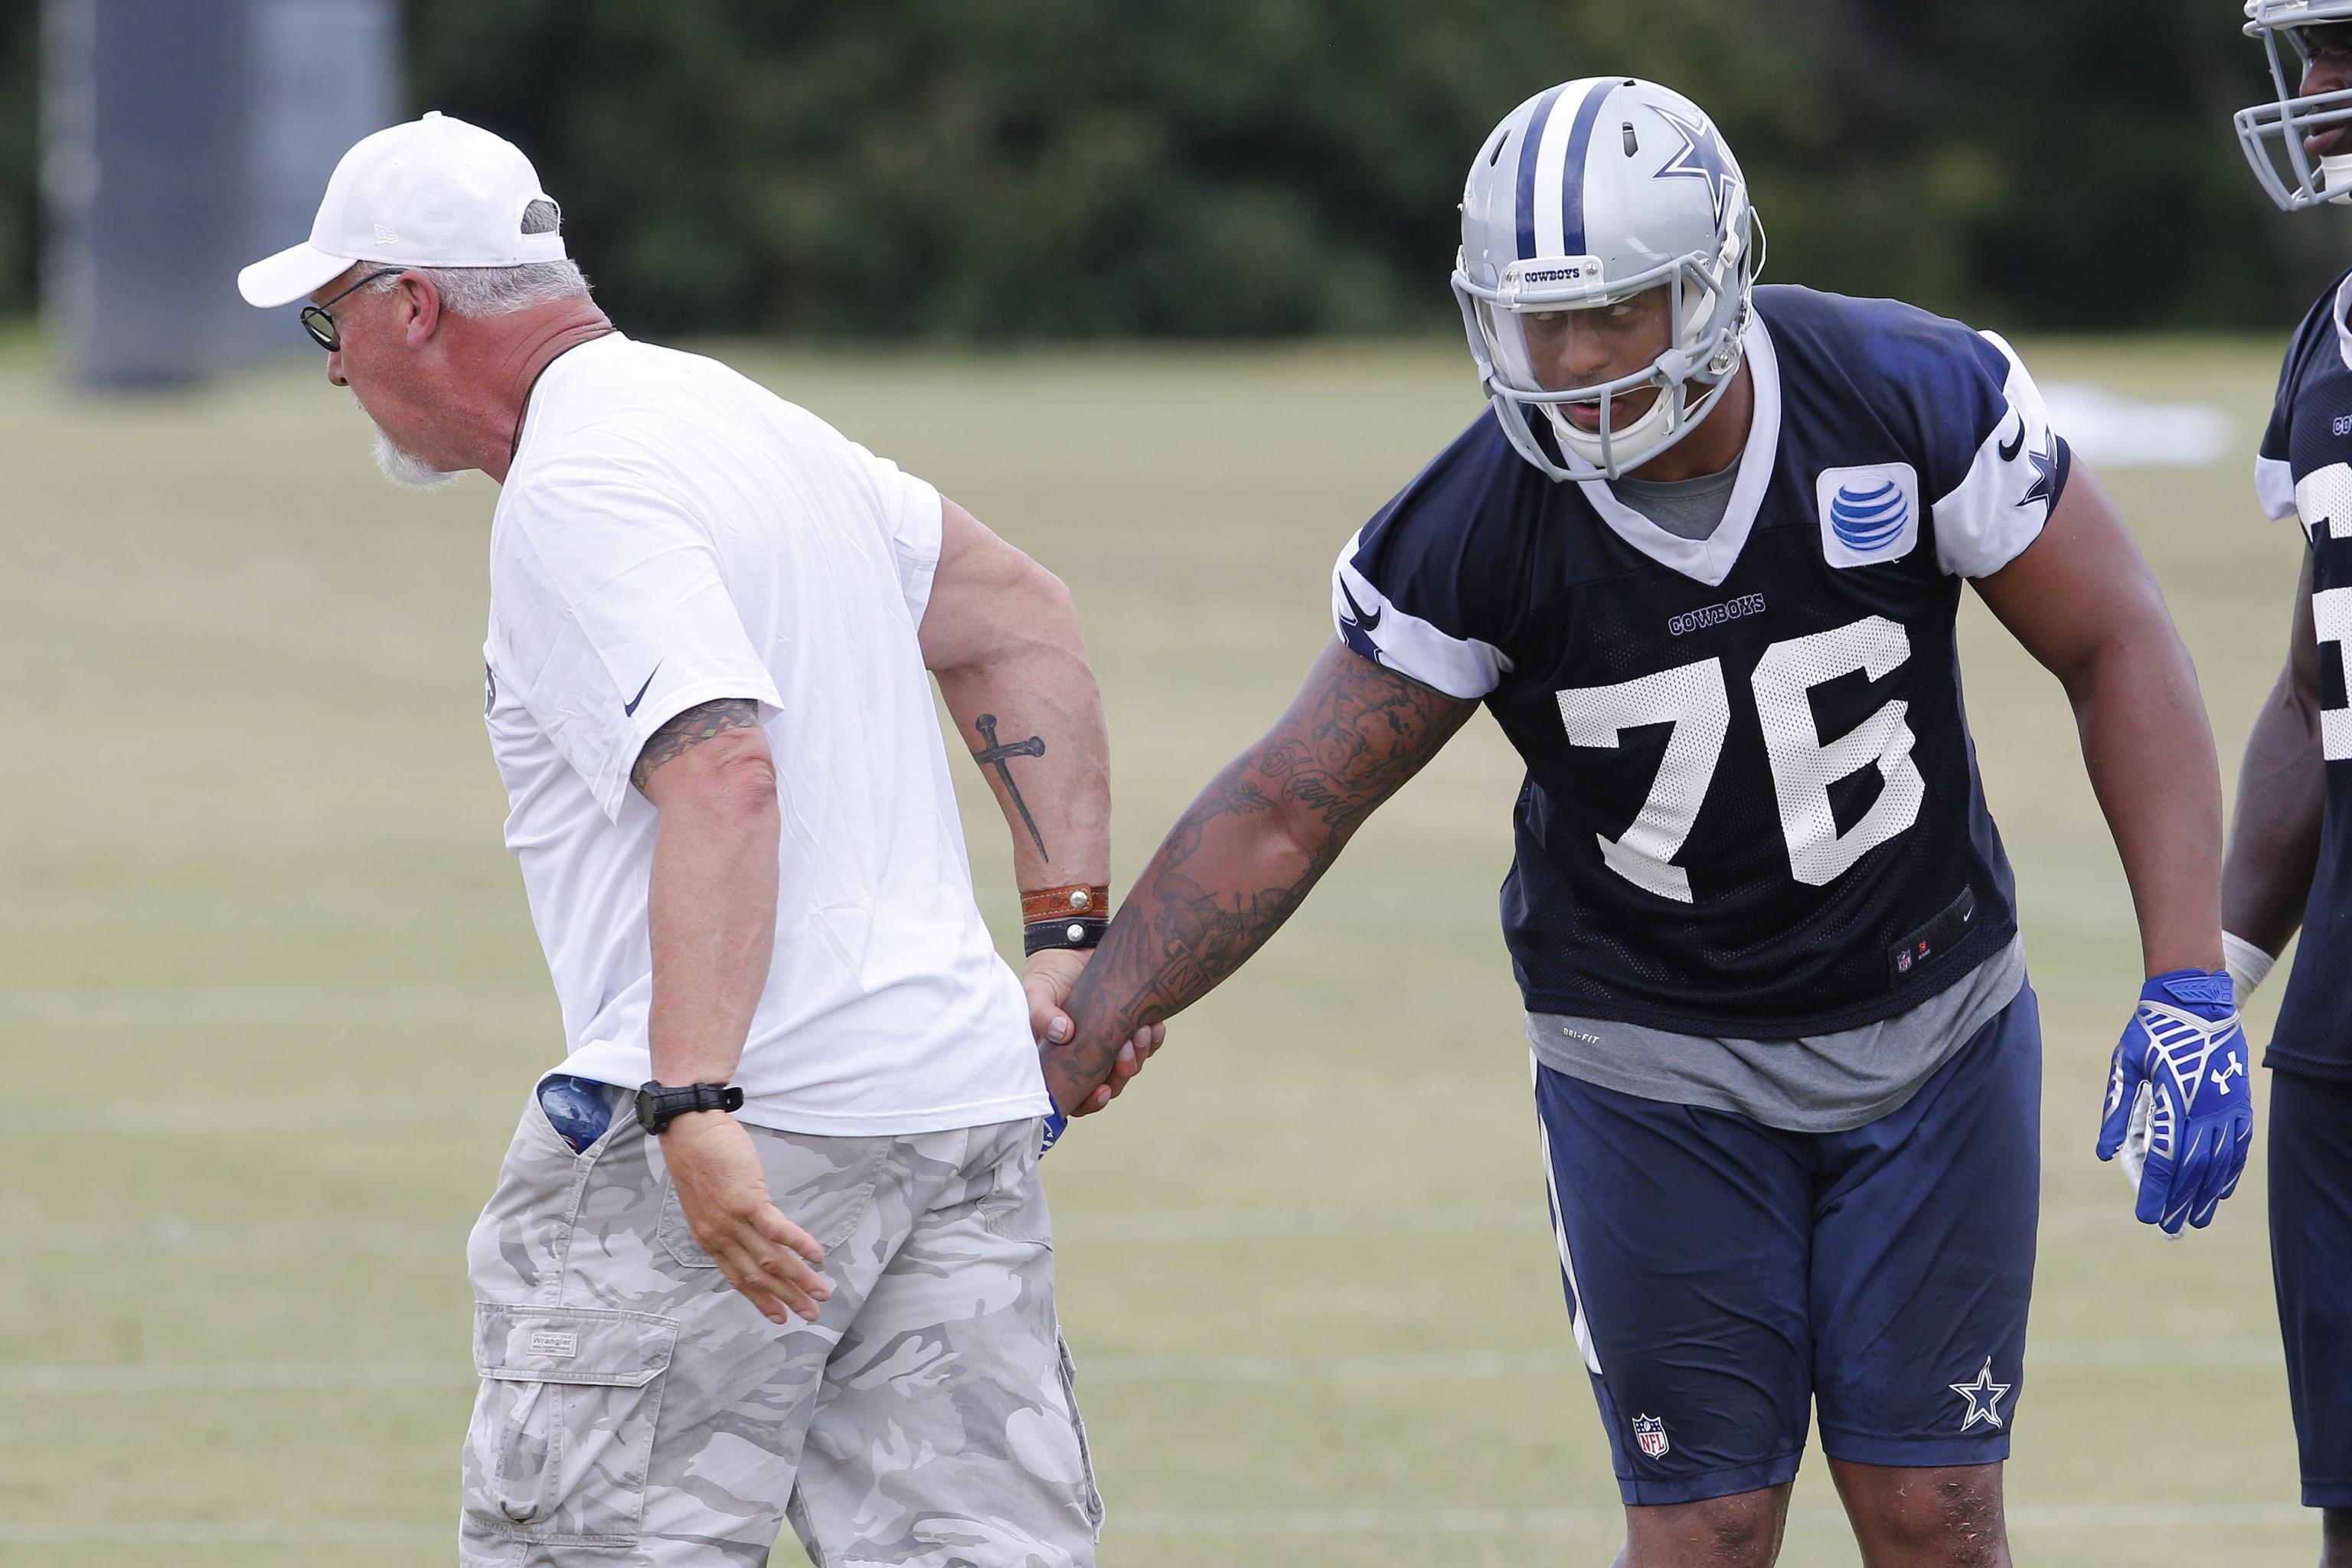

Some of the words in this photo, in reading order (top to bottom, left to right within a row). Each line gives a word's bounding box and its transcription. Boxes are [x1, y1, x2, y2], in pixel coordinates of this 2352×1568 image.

[1524, 268, 1580, 283] COWBOYS
[1668, 593, 1766, 636] COWBOYS
[1555, 614, 1926, 904] 76
[1563, 1027, 1600, 1044] DRI-FIT
[533, 1335, 572, 1346] Wrangler
[1640, 1432, 1665, 1455] NFL
